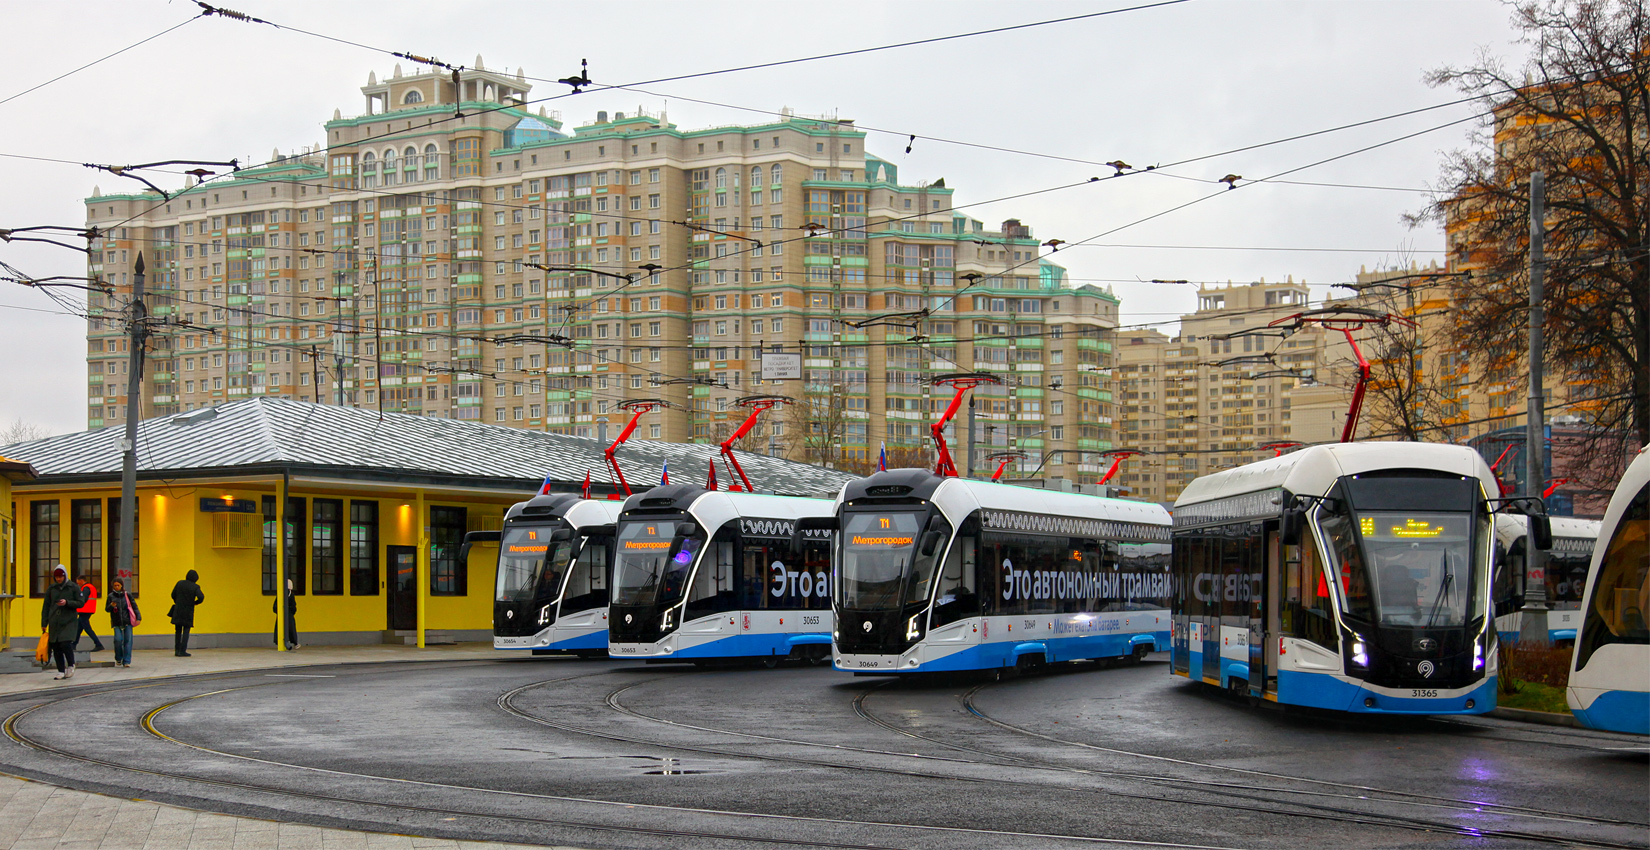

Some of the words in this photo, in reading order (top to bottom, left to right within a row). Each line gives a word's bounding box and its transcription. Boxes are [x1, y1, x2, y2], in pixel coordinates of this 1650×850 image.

[852, 535, 913, 546] Метрогородок
[770, 560, 812, 598] Это
[815, 571, 832, 598] а
[1002, 558, 1032, 600] Это
[1033, 562, 1120, 600] автономный
[803, 616, 820, 625] 30653
[1411, 689, 1438, 698] 31365
